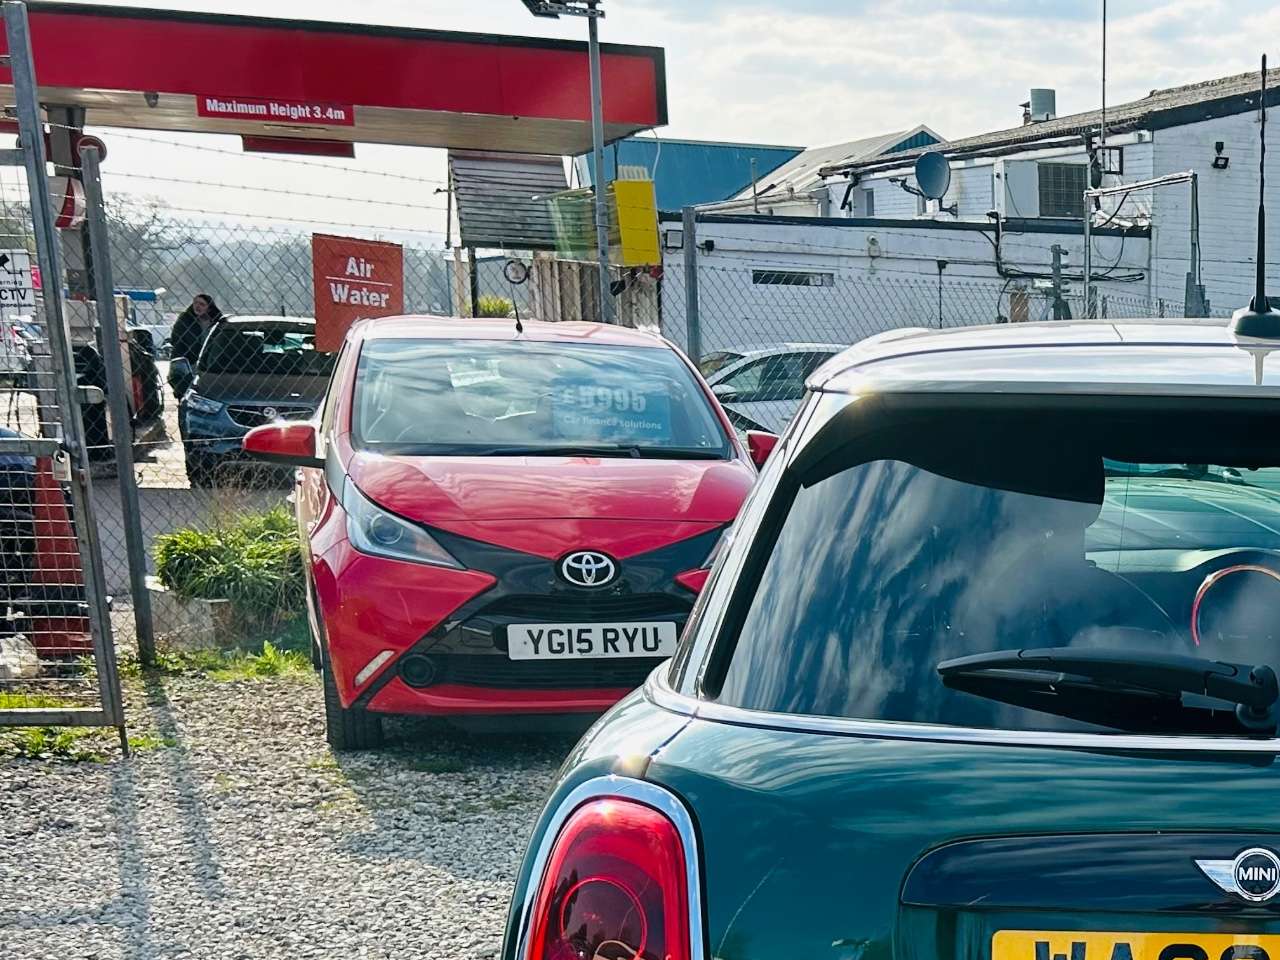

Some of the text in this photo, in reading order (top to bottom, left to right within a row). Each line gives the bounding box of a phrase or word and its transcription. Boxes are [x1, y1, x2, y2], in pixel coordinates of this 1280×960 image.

[206, 99, 345, 120] Maximum Height 3.4m
[345, 256, 375, 278] Air
[329, 283, 390, 307] Water
[620, 419, 662, 429] solutions
[526, 627, 660, 655] YG15 RYU
[1239, 867, 1276, 881] MINI
